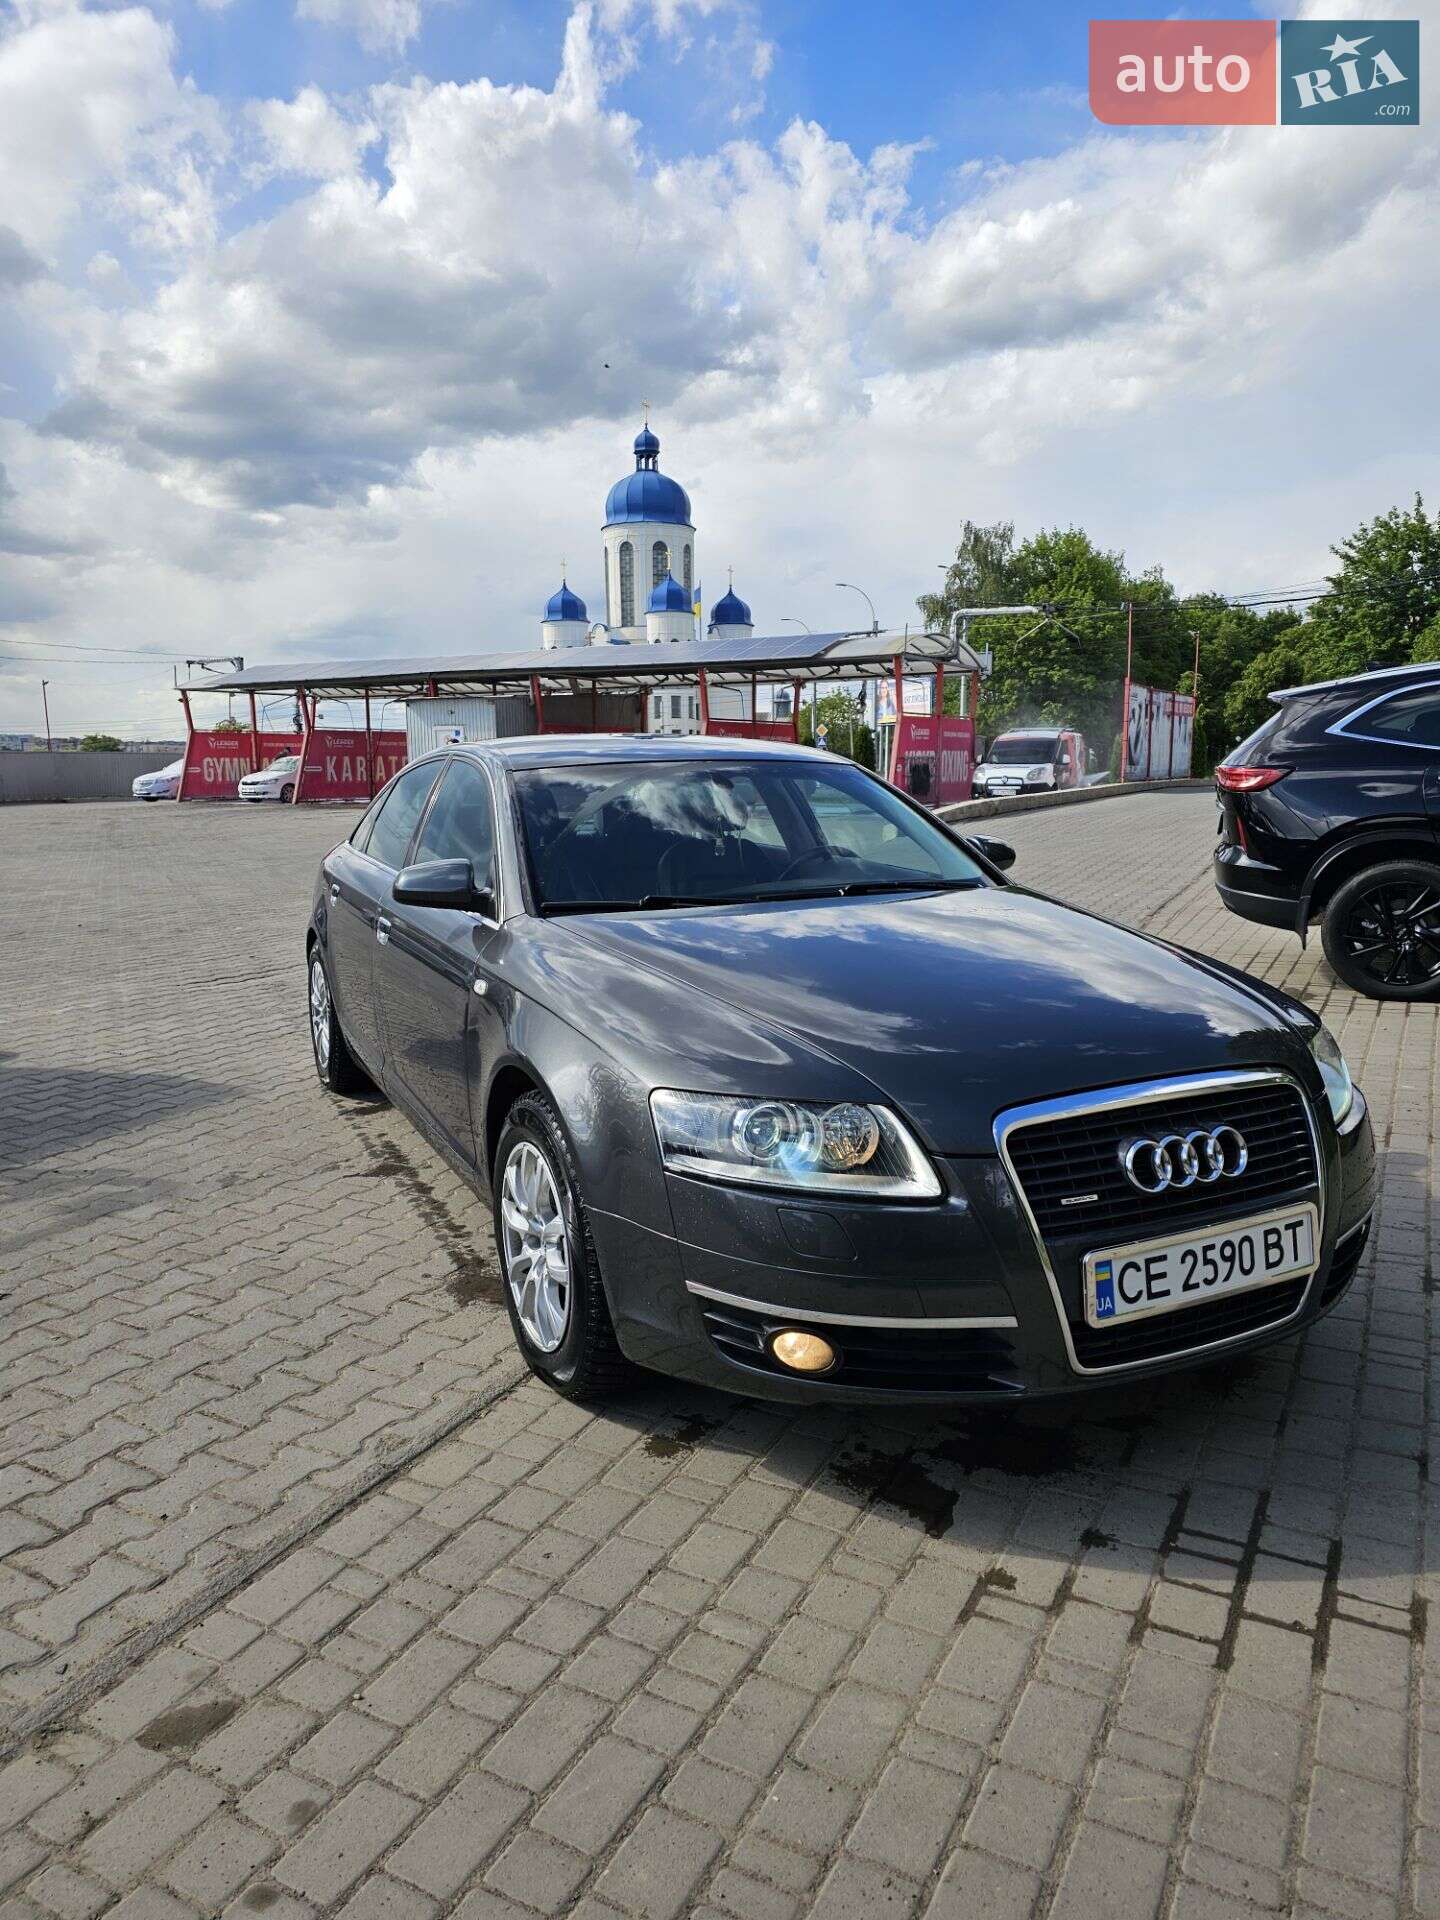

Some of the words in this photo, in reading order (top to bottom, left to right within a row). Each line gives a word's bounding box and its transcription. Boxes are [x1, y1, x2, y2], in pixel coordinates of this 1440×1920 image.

[1117, 1254, 1171, 1305] CE
[1180, 1235, 1255, 1293] 2590
[1263, 1219, 1304, 1271] BT
[1096, 1296, 1113, 1312] UA
